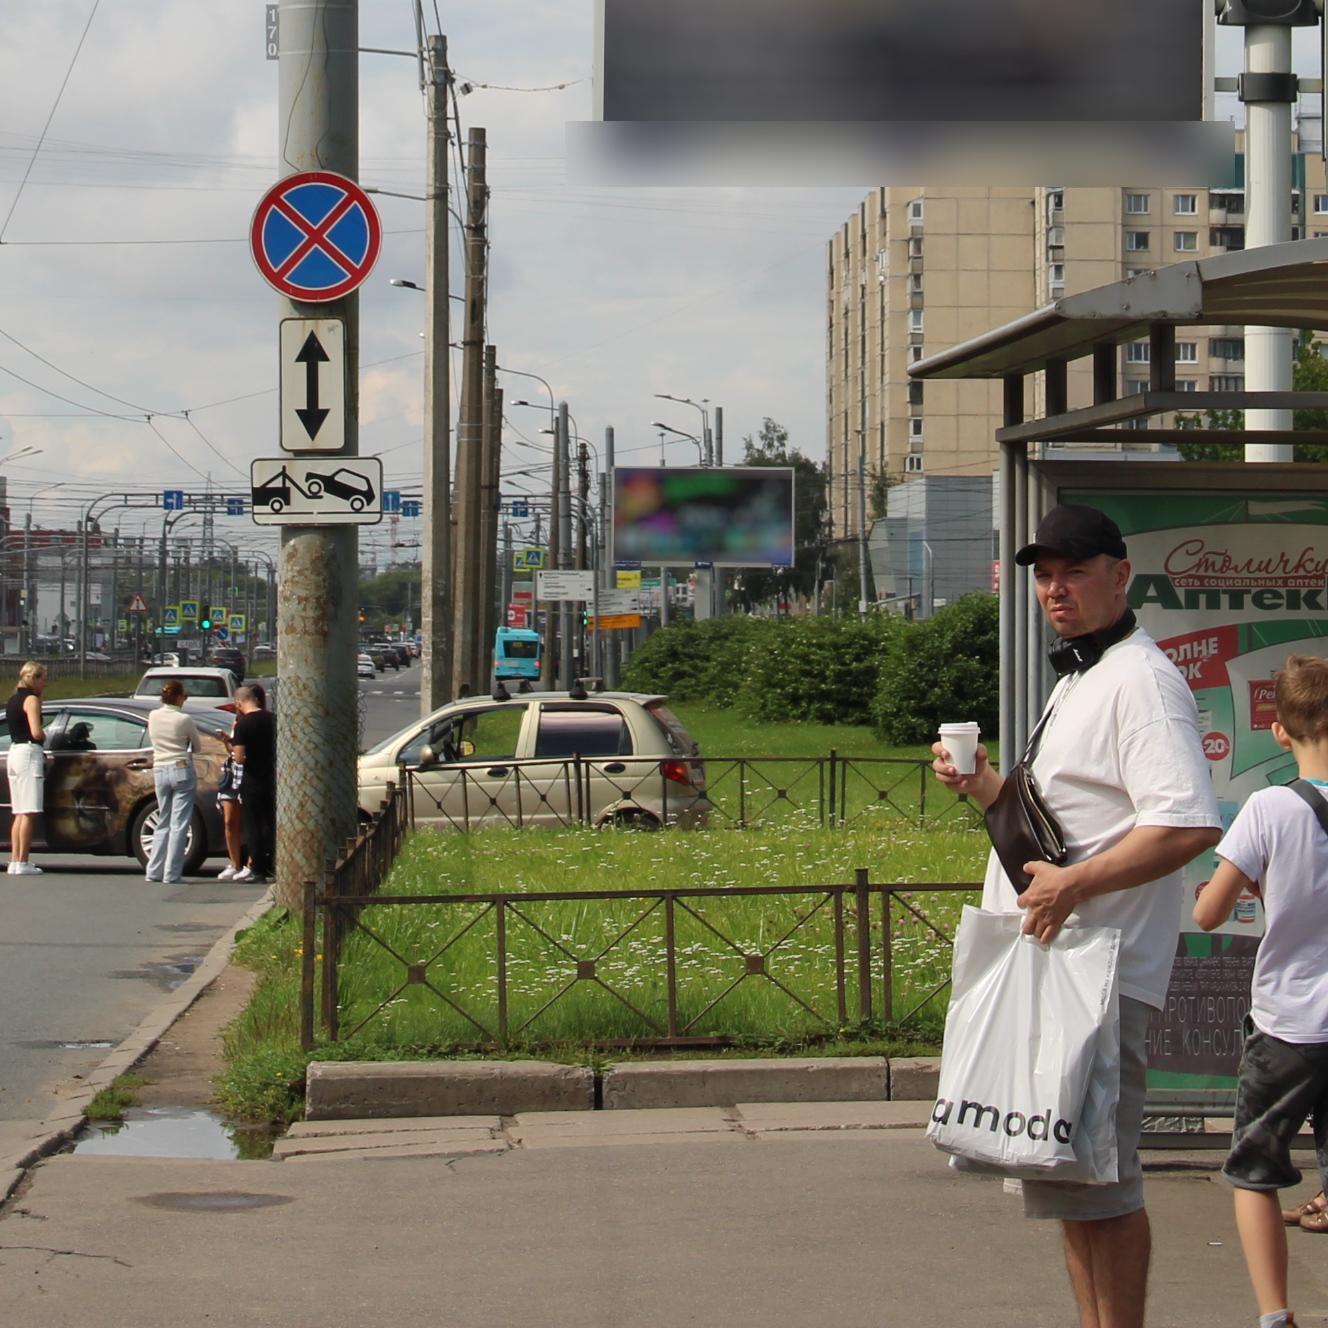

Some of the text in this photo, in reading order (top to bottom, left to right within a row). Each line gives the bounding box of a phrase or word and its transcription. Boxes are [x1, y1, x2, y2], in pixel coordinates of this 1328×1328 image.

[1174, 578, 1326, 589] сеть социальных аптек
